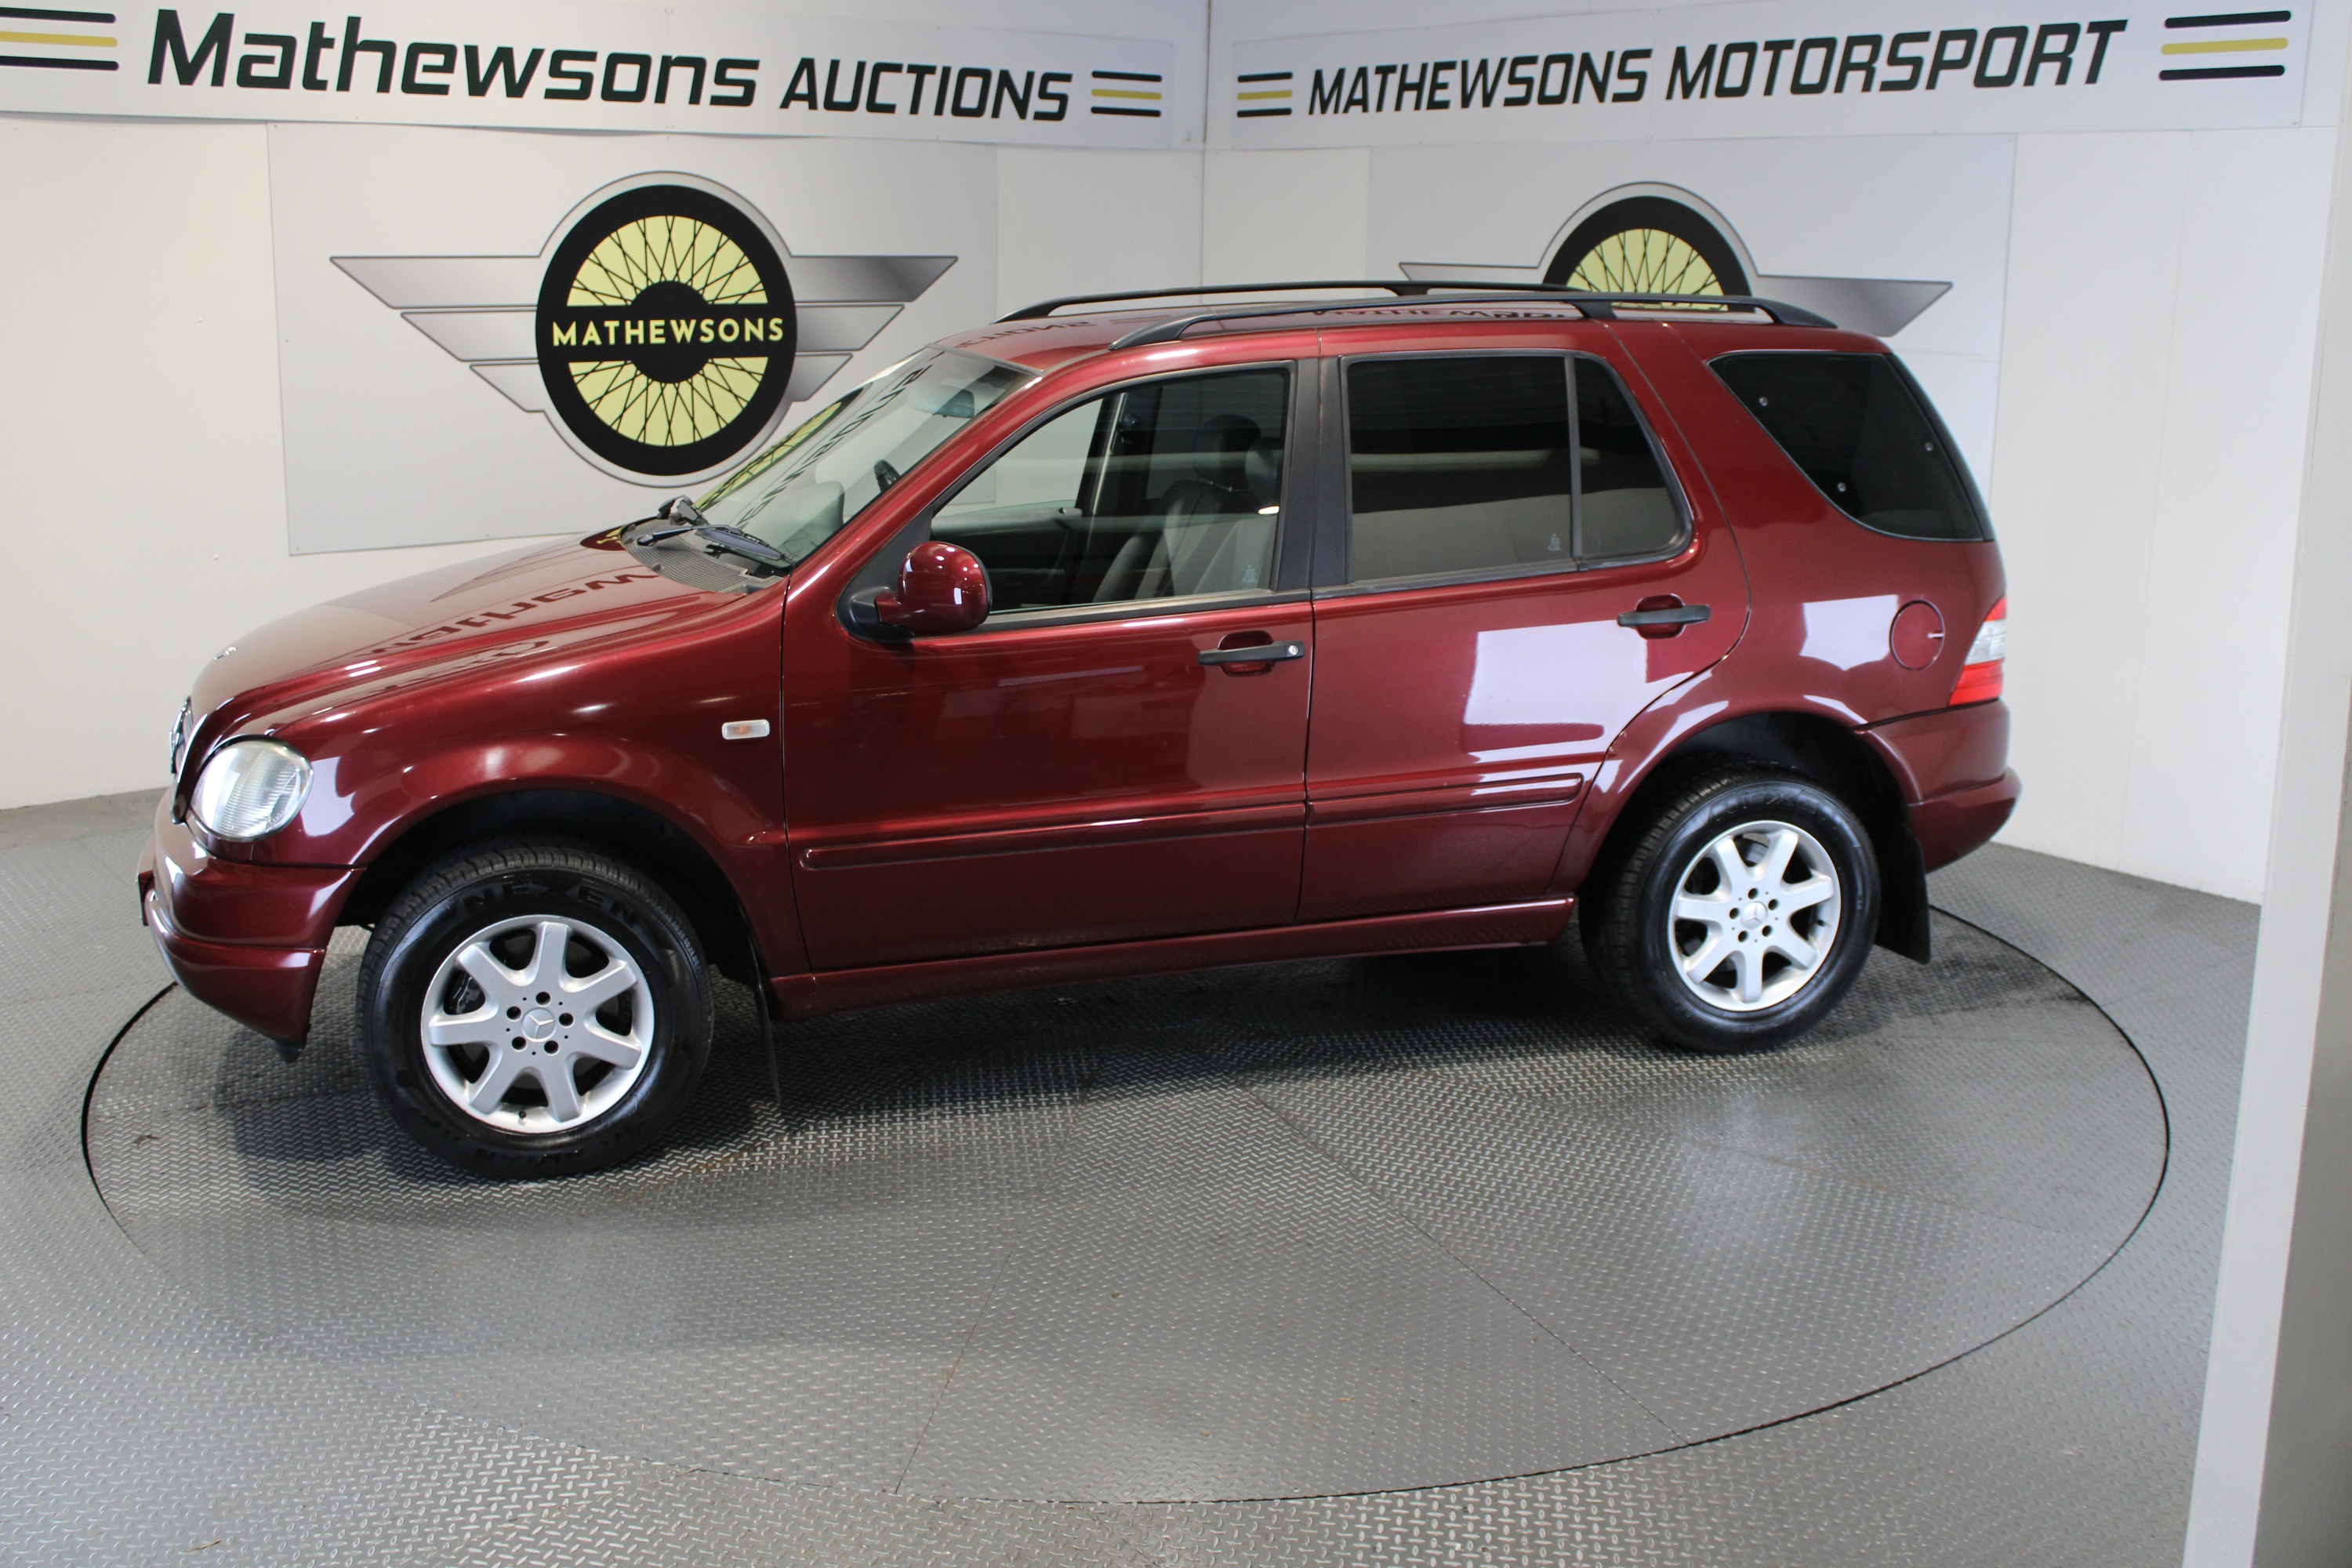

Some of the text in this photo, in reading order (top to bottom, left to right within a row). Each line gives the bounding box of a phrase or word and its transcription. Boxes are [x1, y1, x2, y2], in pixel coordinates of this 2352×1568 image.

[147, 9, 1073, 122] Mathewsons AUCTIONS
[1308, 19, 2129, 116] MATHEWSONS MOTORSPORT
[552, 318, 784, 347] MATHEWSONS
